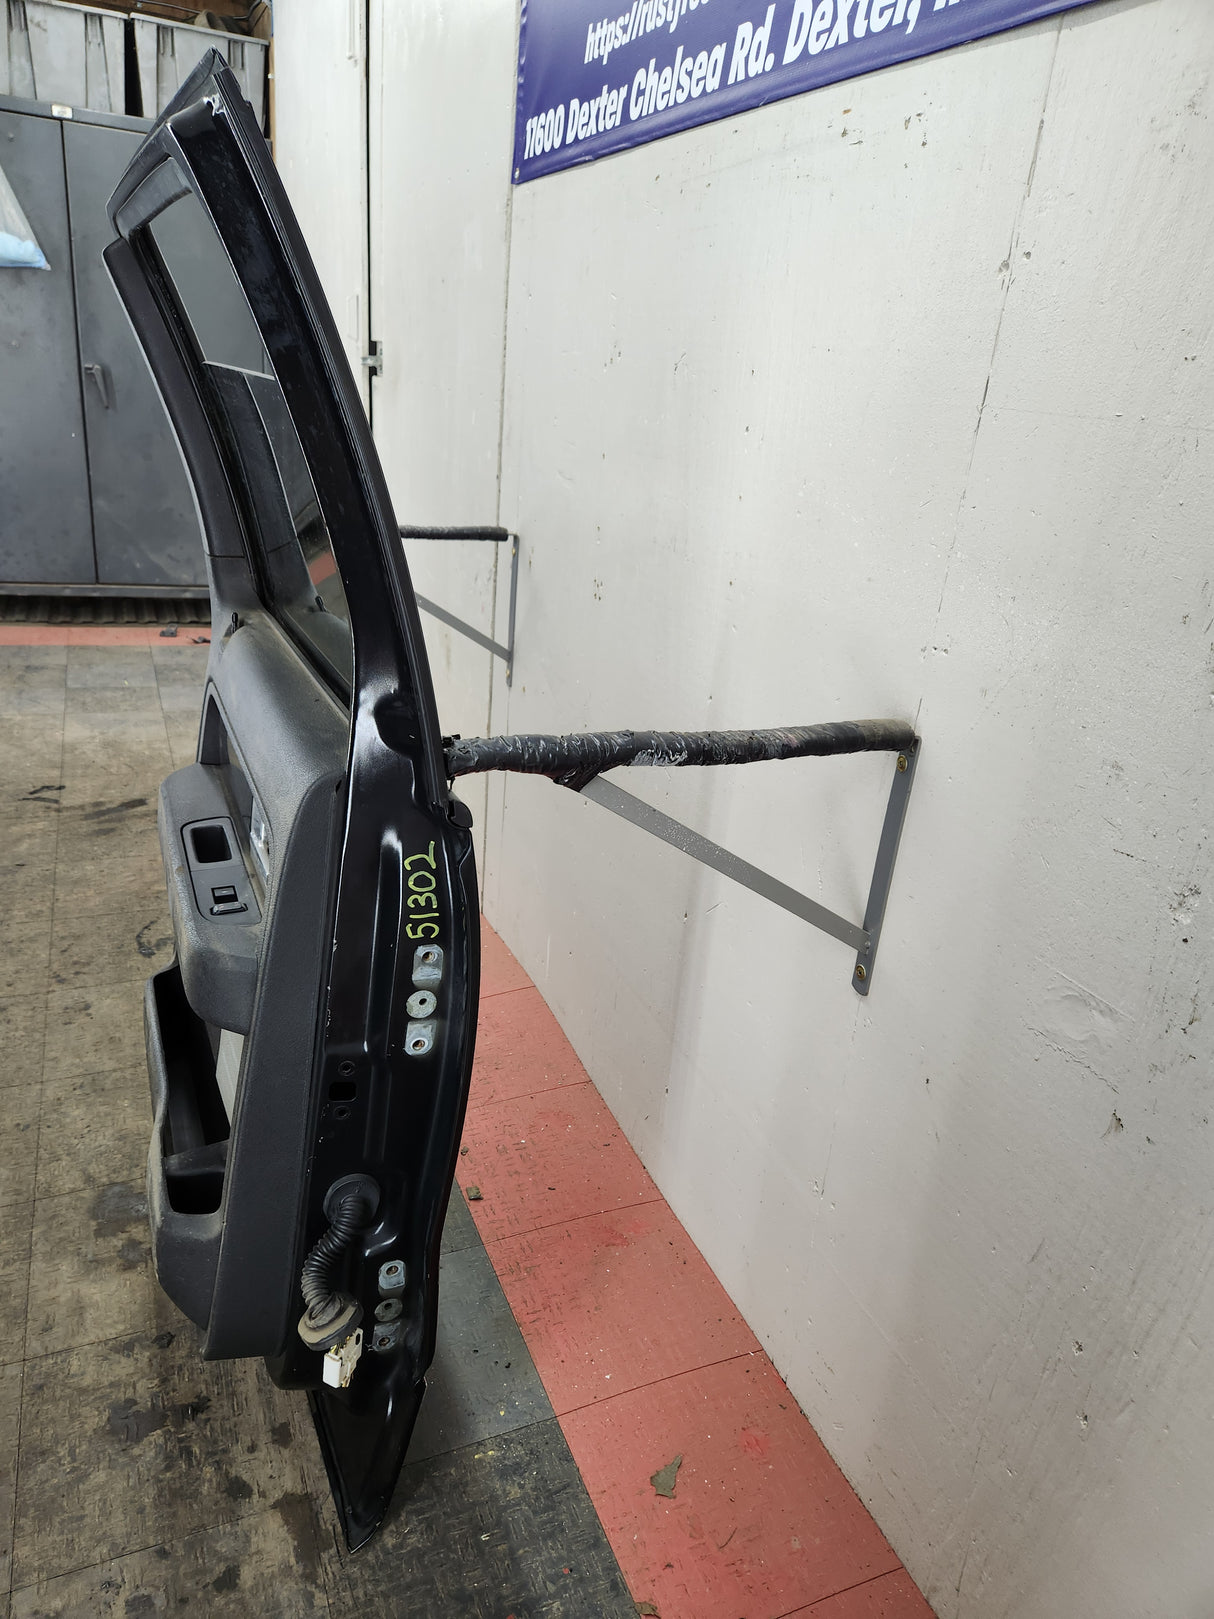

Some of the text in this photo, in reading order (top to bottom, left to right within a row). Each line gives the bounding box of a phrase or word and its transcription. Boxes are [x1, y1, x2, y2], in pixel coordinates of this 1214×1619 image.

[524, 104, 565, 160] 11600
[566, 84, 628, 144] Dexter
[630, 42, 727, 120] Chelsea
[727, 3, 776, 85] Rd.
[584, 0, 709, 65] https://rusty
[404, 841, 439, 939] 51302
